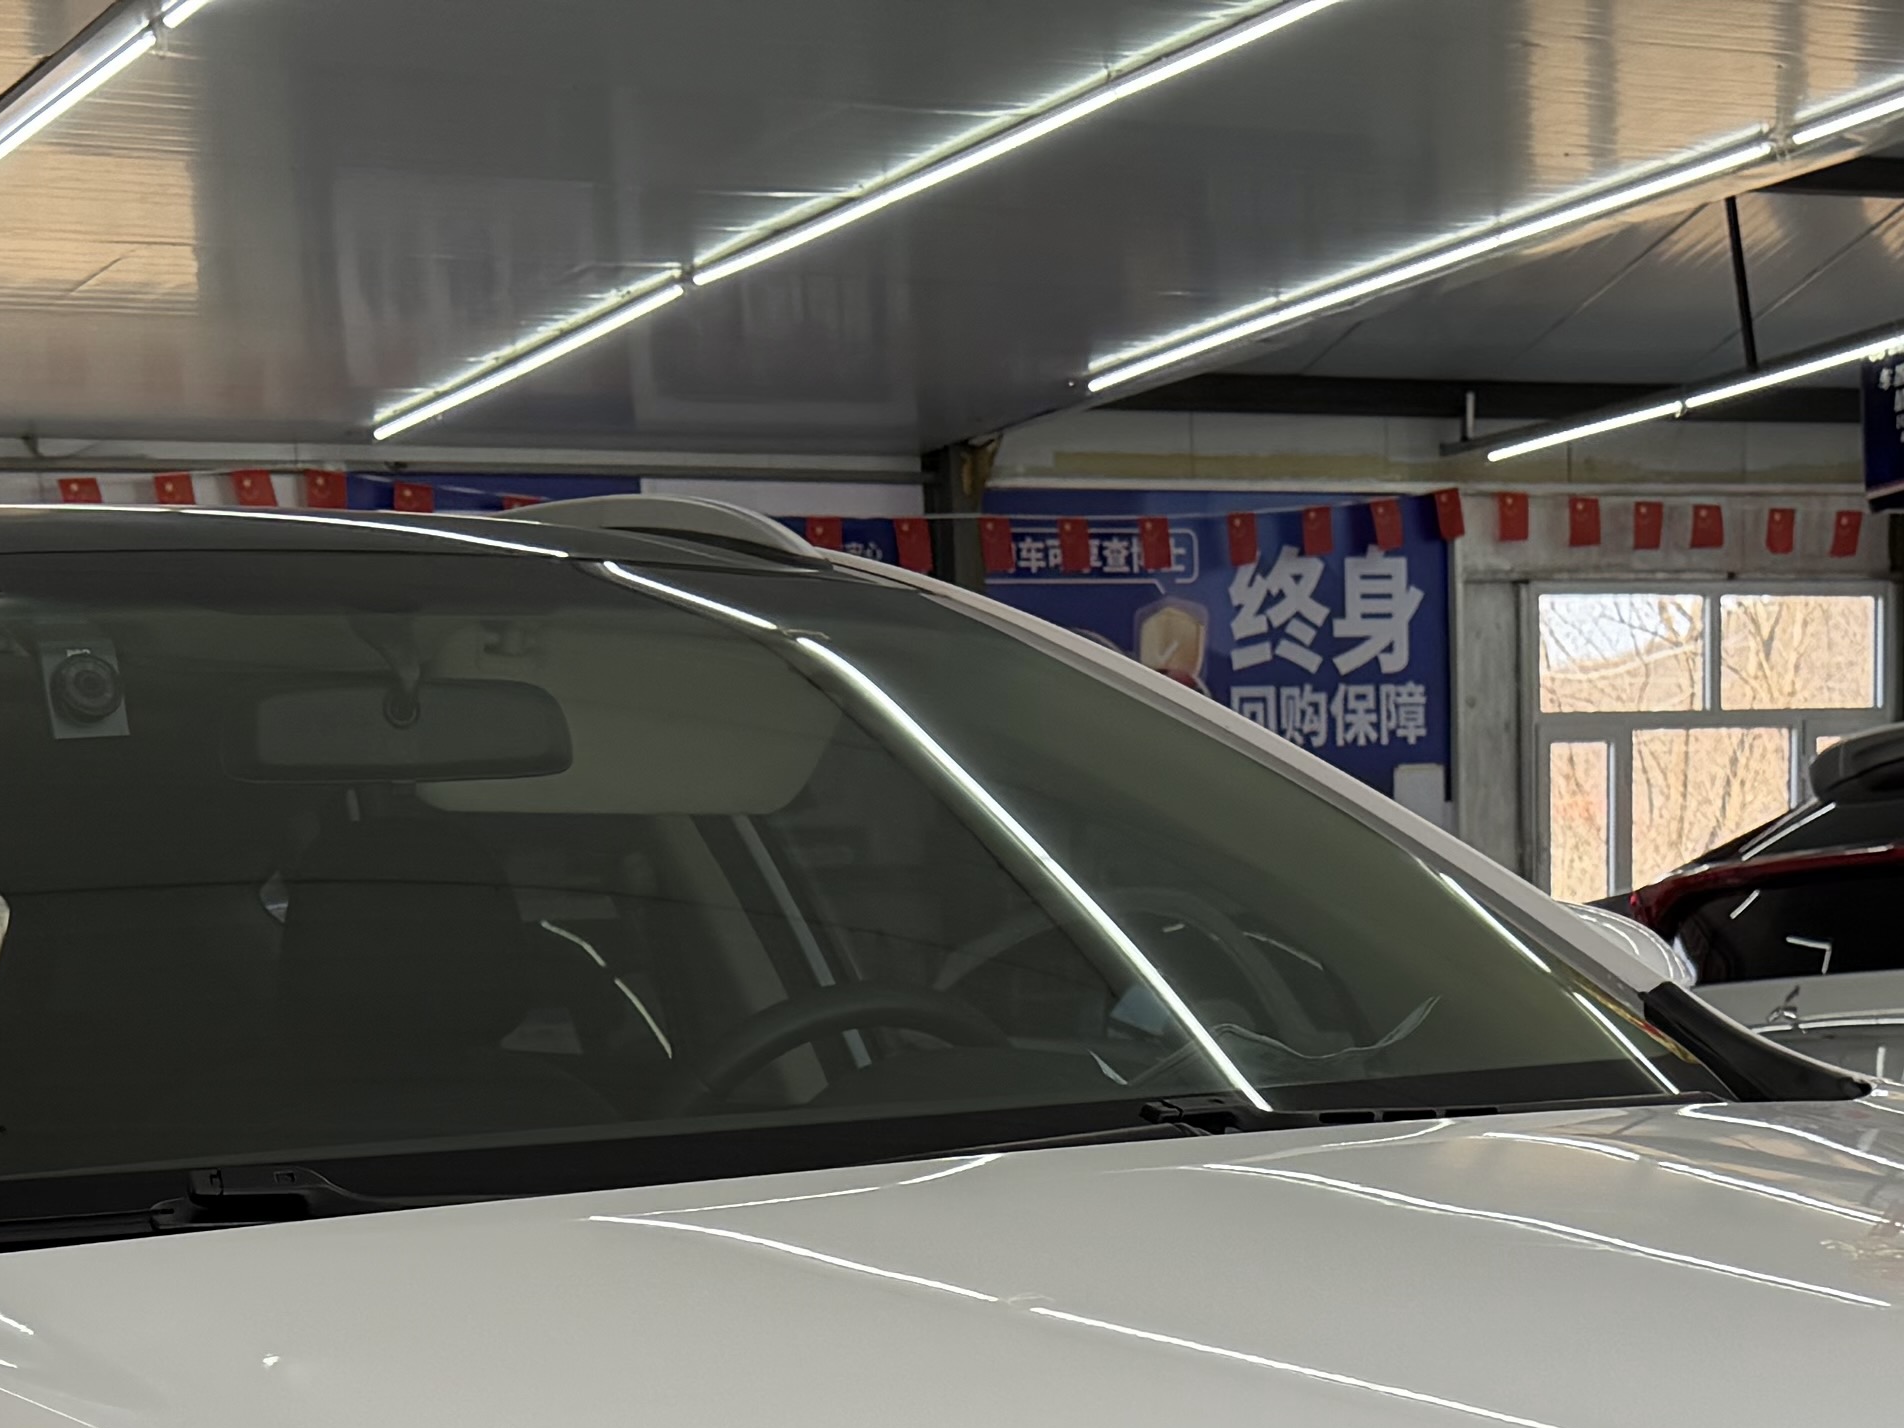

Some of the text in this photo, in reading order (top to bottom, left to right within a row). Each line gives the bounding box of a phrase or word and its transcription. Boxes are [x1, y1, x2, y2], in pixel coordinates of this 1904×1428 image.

[1227, 544, 1426, 676] 终身
[1229, 682, 1427, 748] 回购保障
